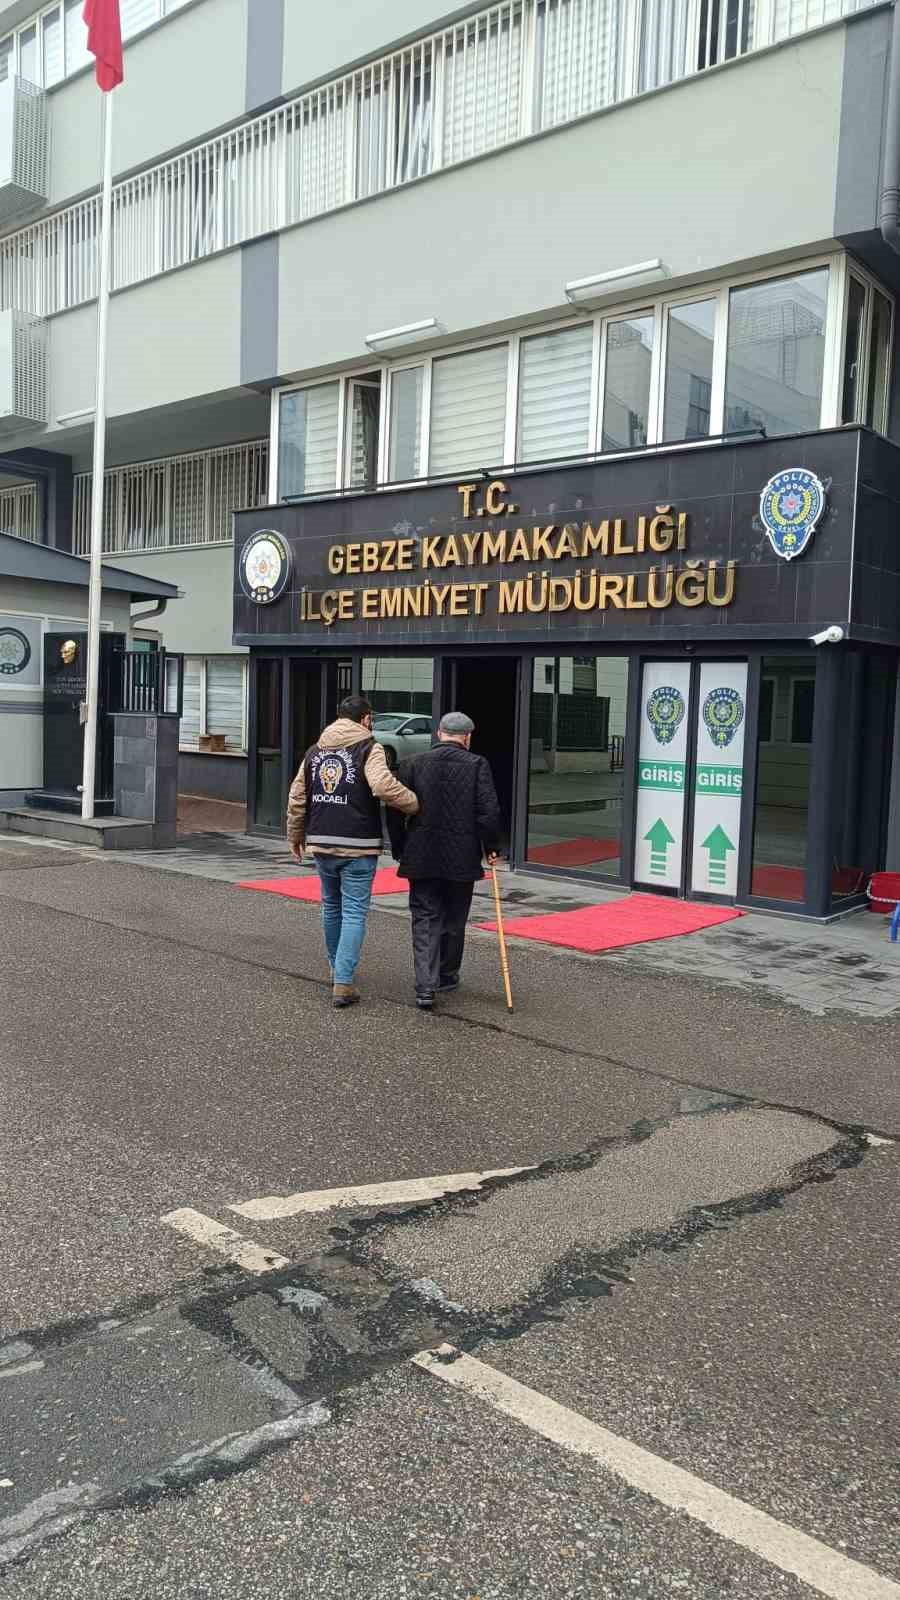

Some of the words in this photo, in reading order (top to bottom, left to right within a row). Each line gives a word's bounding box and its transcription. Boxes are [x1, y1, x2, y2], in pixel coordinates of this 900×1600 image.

[457, 481, 519, 518] T.C.
[328, 538, 416, 575] GEBZE
[421, 504, 687, 569] KAYMAKAMLIĞI
[300, 586, 355, 626] İLÇE
[362, 579, 489, 618] EMNİYET
[498, 559, 737, 614] MÜDÜRLÜĞÜ
[641, 766, 683, 786] GİRİŞ
[697, 769, 742, 791] GİRİŞ
